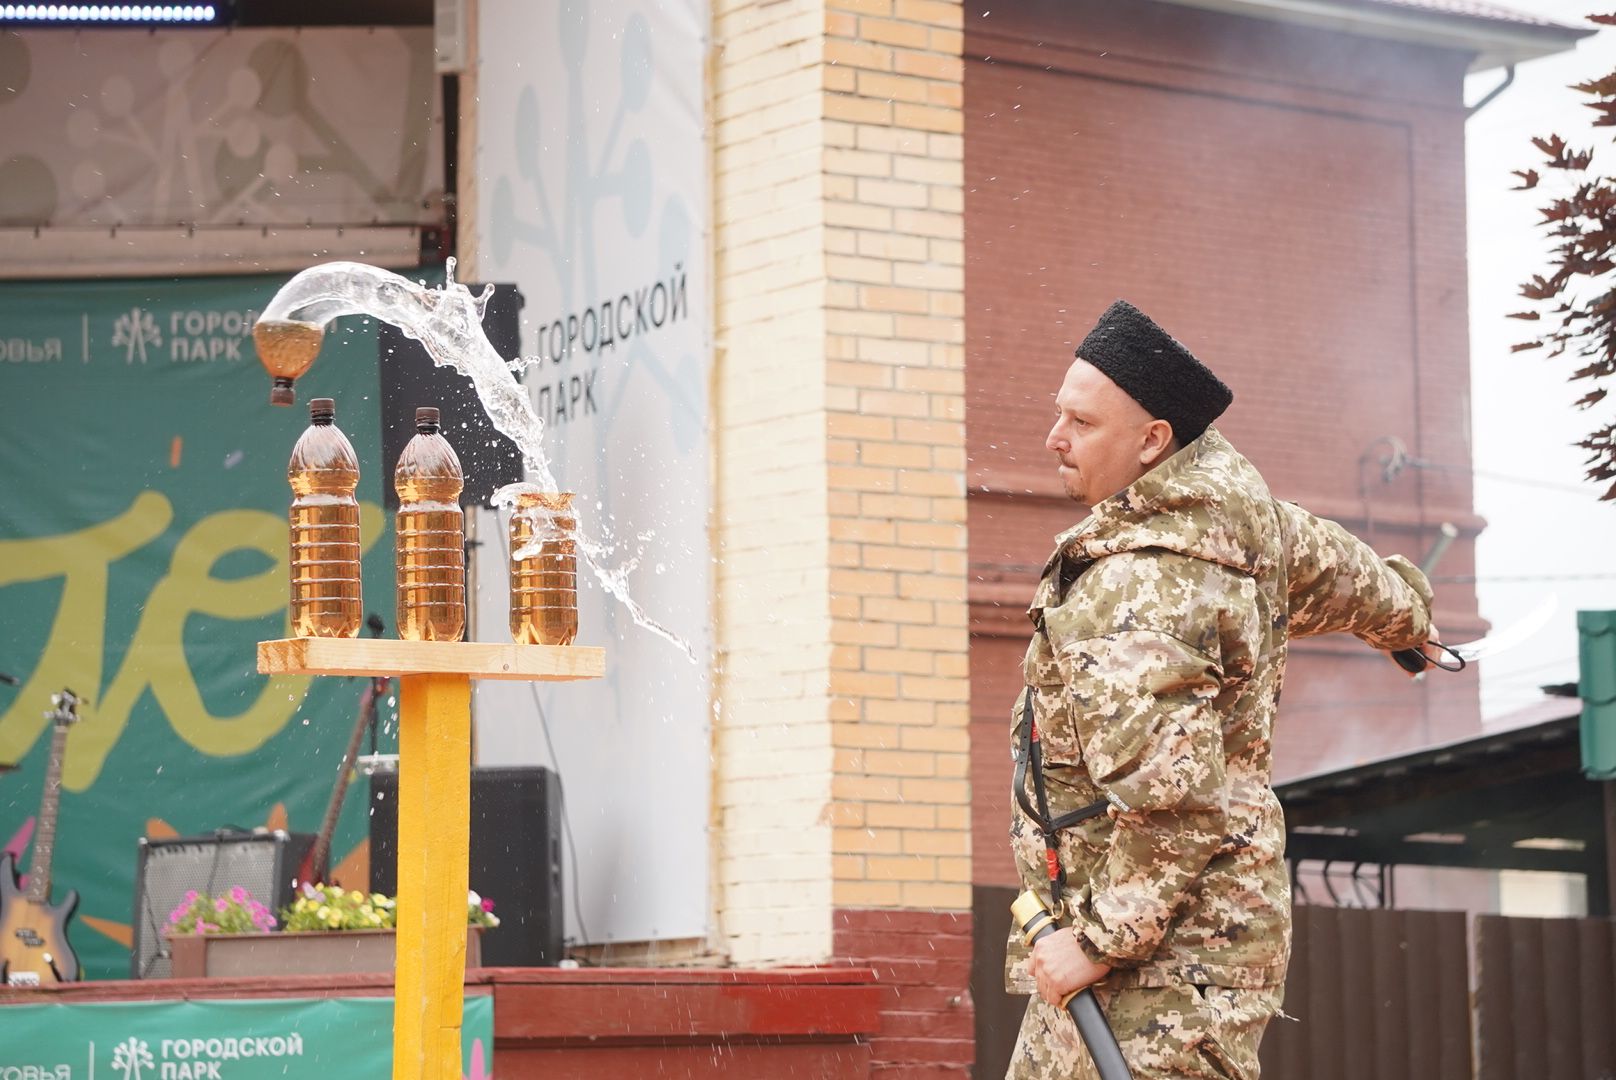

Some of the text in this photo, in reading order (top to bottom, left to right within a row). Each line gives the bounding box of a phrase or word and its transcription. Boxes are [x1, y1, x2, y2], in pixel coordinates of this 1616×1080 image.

[538, 262, 688, 369] ГОРОДСКОЙ
[170, 337, 242, 361] ПАРК
[538, 368, 597, 428] ПАРК
[161, 1032, 303, 1060] ГОРОДСКОЙ
[161, 1061, 222, 1080] ПАРК
